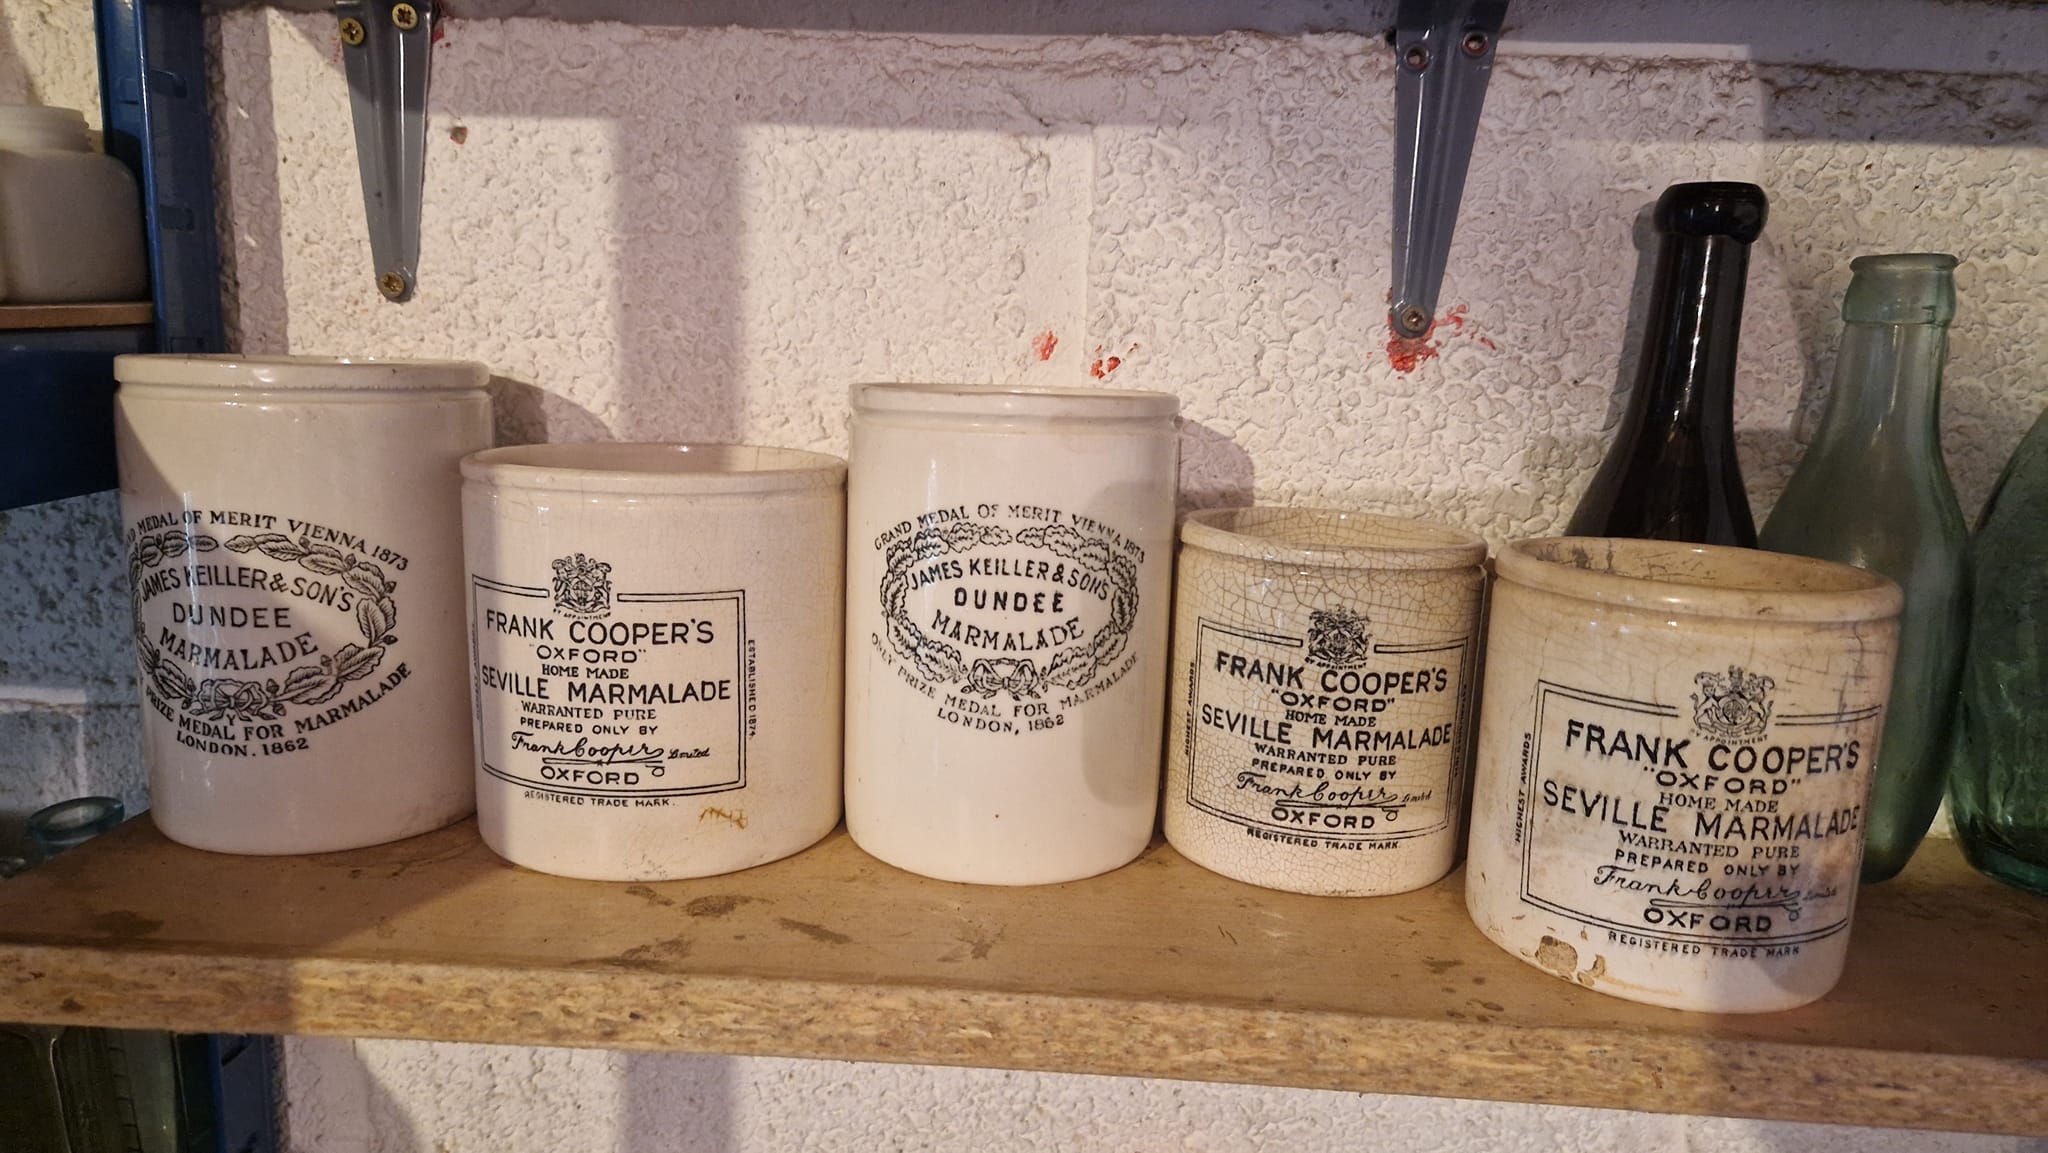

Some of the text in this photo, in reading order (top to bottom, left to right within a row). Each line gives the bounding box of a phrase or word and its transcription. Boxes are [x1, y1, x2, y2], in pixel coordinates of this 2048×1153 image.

[137, 510, 409, 571] MEDAL OF MERIT VIENNA 1873
[874, 520, 912, 551] GRAND
[917, 505, 970, 528] MEDAL
[978, 503, 999, 518] OF
[1008, 504, 1062, 523] MERIT
[1072, 514, 1121, 547] VIENNA
[141, 568, 181, 602] JAMES
[910, 560, 964, 590] JAMES
[954, 587, 1064, 613] DUNDEE
[173, 602, 291, 628] DUNDEE
[486, 608, 715, 645] FRANK COOPER'S
[931, 609, 1085, 651] MARMALADE
[159, 627, 318, 670] MARMALADE
[529, 643, 647, 664] "OXFORD"
[481, 665, 731, 705] SEVILLE MARMALADE
[541, 664, 630, 680] HOME MADE
[748, 639, 757, 713] ESTABLISHED
[897, 667, 937, 699] PRIZE
[944, 693, 1002, 718] MEDAL
[1013, 703, 1050, 718] FOR
[1060, 651, 1138, 710] MARMALADE
[1216, 651, 1448, 695] FRANK COOPER'S
[146, 662, 412, 741] PRIZE MEDAL FOR MARMALADE
[521, 700, 657, 721] WARRANTED PURE
[1184, 662, 1195, 756] HIGHEST AWARDS
[1271, 688, 1395, 713] "OXFORD"
[520, 716, 658, 735] PREPARED ONLY BY
[1028, 713, 1065, 732] 1862
[1201, 703, 1452, 752] SEVILLE MARMALADE
[1285, 709, 1377, 728] HOME MADE
[261, 737, 310, 756] 1862
[511, 731, 567, 757] Frank
[1566, 719, 1860, 774] FRANK COOPER'S
[1704, 734, 1768, 745] APPOINTMENT
[1254, 742, 1397, 766] WARRANTED PURE
[540, 766, 640, 785] OXFORD
[1252, 758, 1397, 781] PREPARED ONLY BY
[1643, 766, 1801, 794] "OXFORD"
[1237, 771, 1303, 799] Frank
[1515, 732, 1532, 843] HIGHEST AWARDS
[524, 790, 585, 806] REGISTERED
[590, 797, 629, 808] TRADE
[1543, 779, 1669, 834] SEVILLE
[1695, 805, 1860, 841] MARMALADE
[1659, 792, 1778, 813] HOME MADE
[1271, 807, 1376, 830] OXFORD
[1247, 828, 1399, 850] REGISTERED TRADE MARK
[1618, 829, 1800, 860] WARRANTED PURE
[1615, 849, 1799, 876] PREPARED ONLY BY
[1594, 864, 1686, 897] Frank
[1643, 907, 1771, 932] OXFORD
[1608, 931, 1800, 957] REGISTERED TRADE MARK
